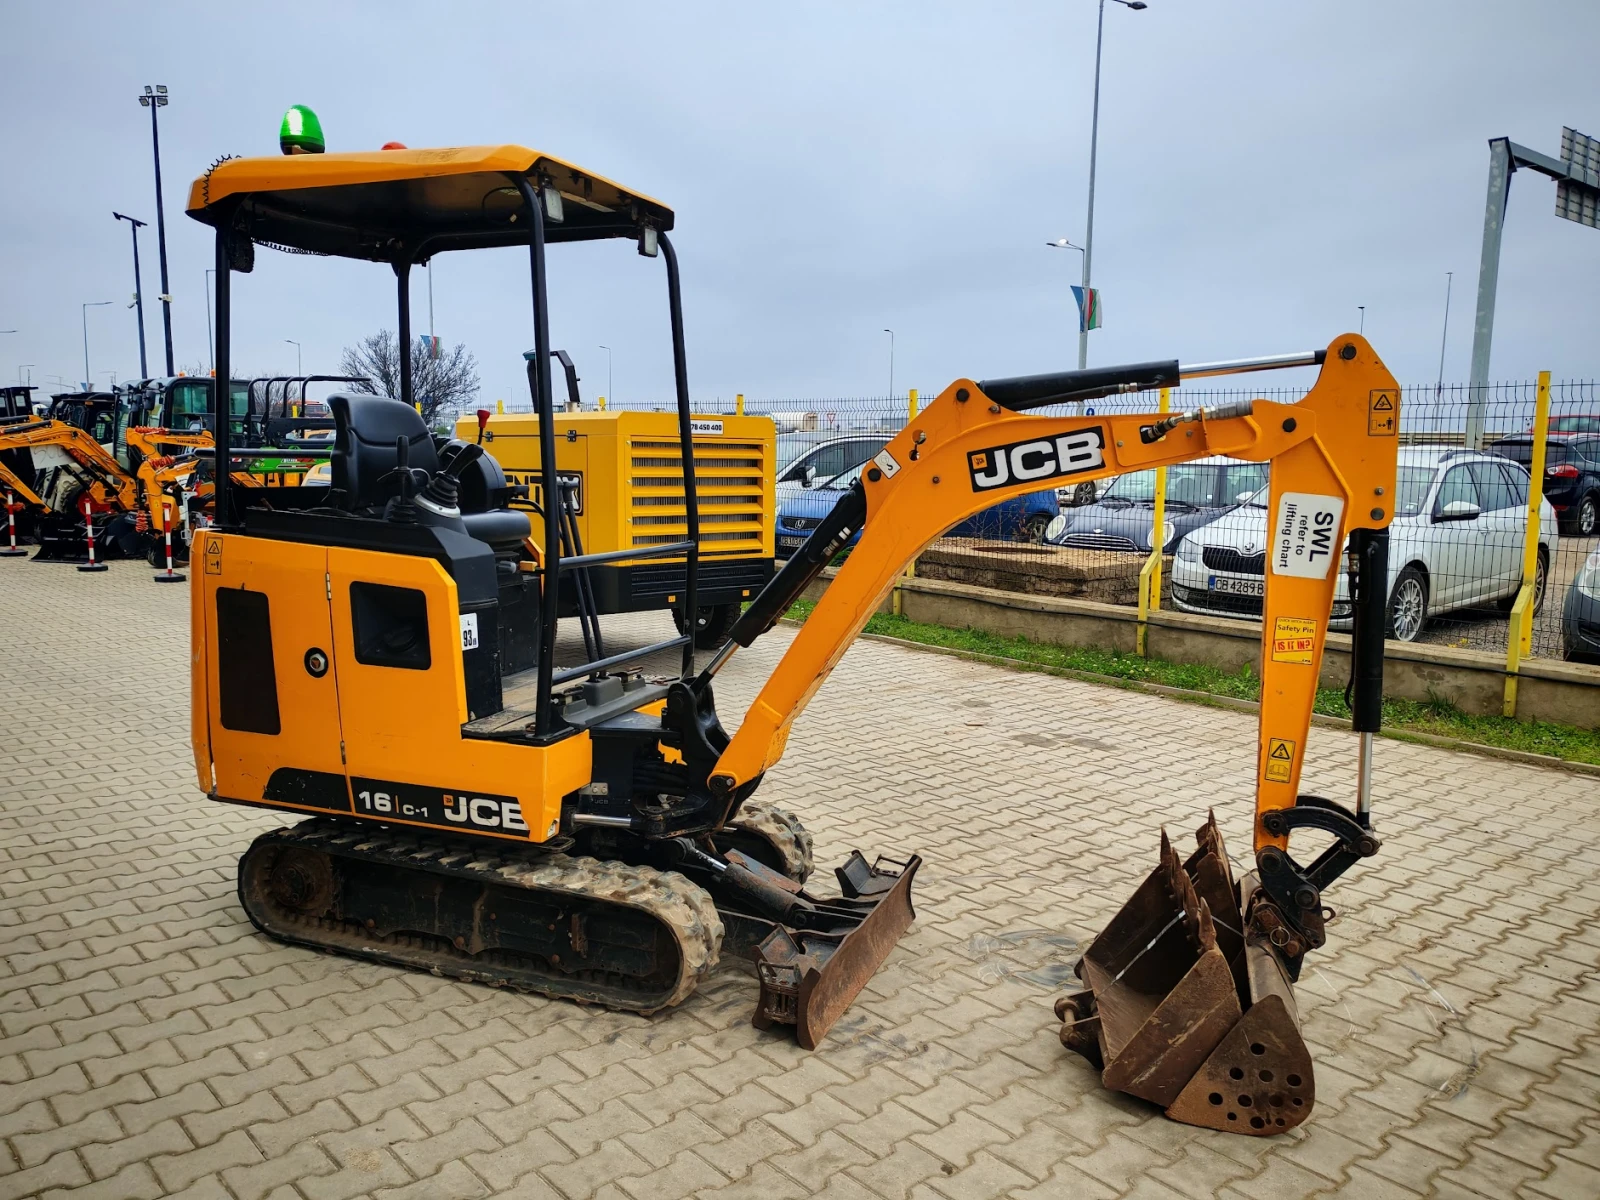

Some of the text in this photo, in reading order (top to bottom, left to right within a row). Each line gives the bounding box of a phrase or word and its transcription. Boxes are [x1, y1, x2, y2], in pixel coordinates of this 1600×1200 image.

[974, 432, 1103, 487] JCB
[1279, 503, 1298, 568] lifting chart
[1295, 515, 1308, 556] refer to
[1308, 511, 1334, 562] SWL
[1216, 579, 1228, 590] CB
[1230, 581, 1256, 594] 4289
[463, 629, 473, 647] 93
[1277, 624, 1300, 633] Safety
[1277, 641, 1286, 651] IS
[1288, 640, 1294, 650] IT
[359, 791, 392, 812] 16
